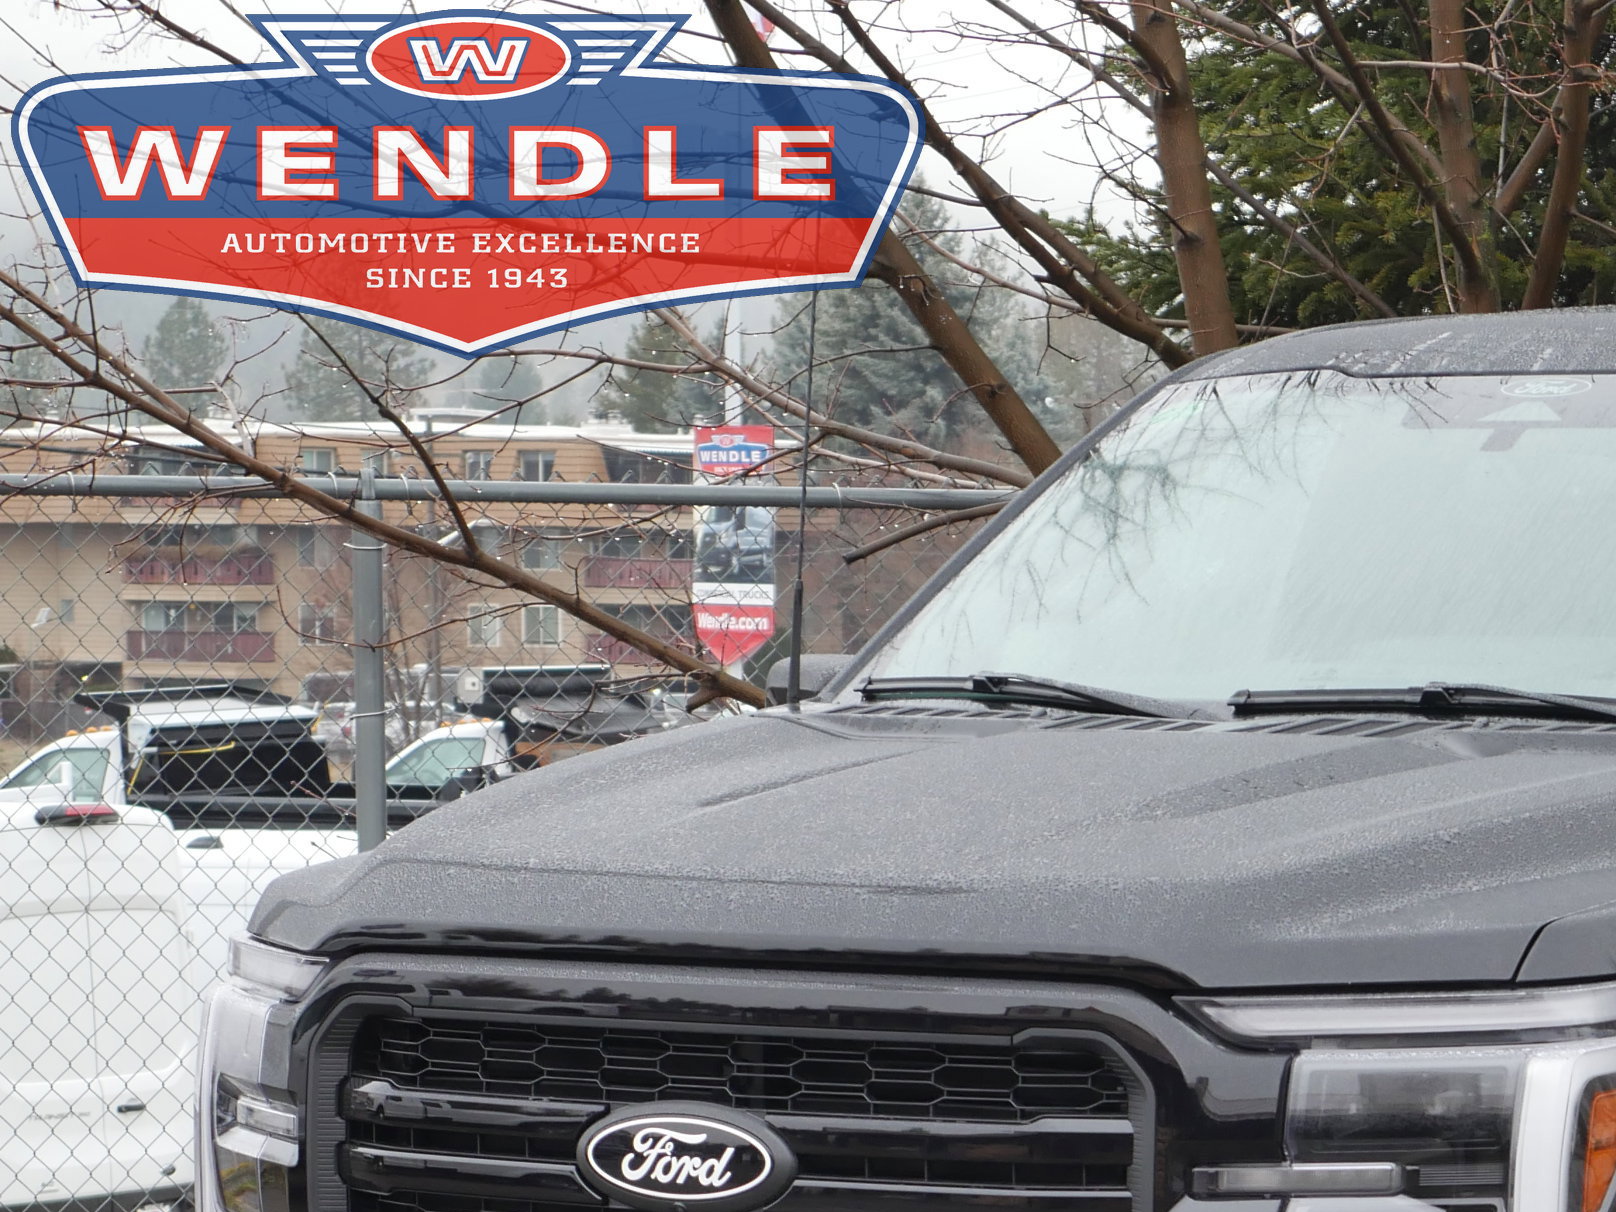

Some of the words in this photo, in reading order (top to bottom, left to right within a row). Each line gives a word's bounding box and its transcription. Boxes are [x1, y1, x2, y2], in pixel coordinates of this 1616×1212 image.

[700, 450, 762, 462] WENDLE
[697, 612, 769, 630] Wendle.com
[621, 1127, 735, 1187] Ford
